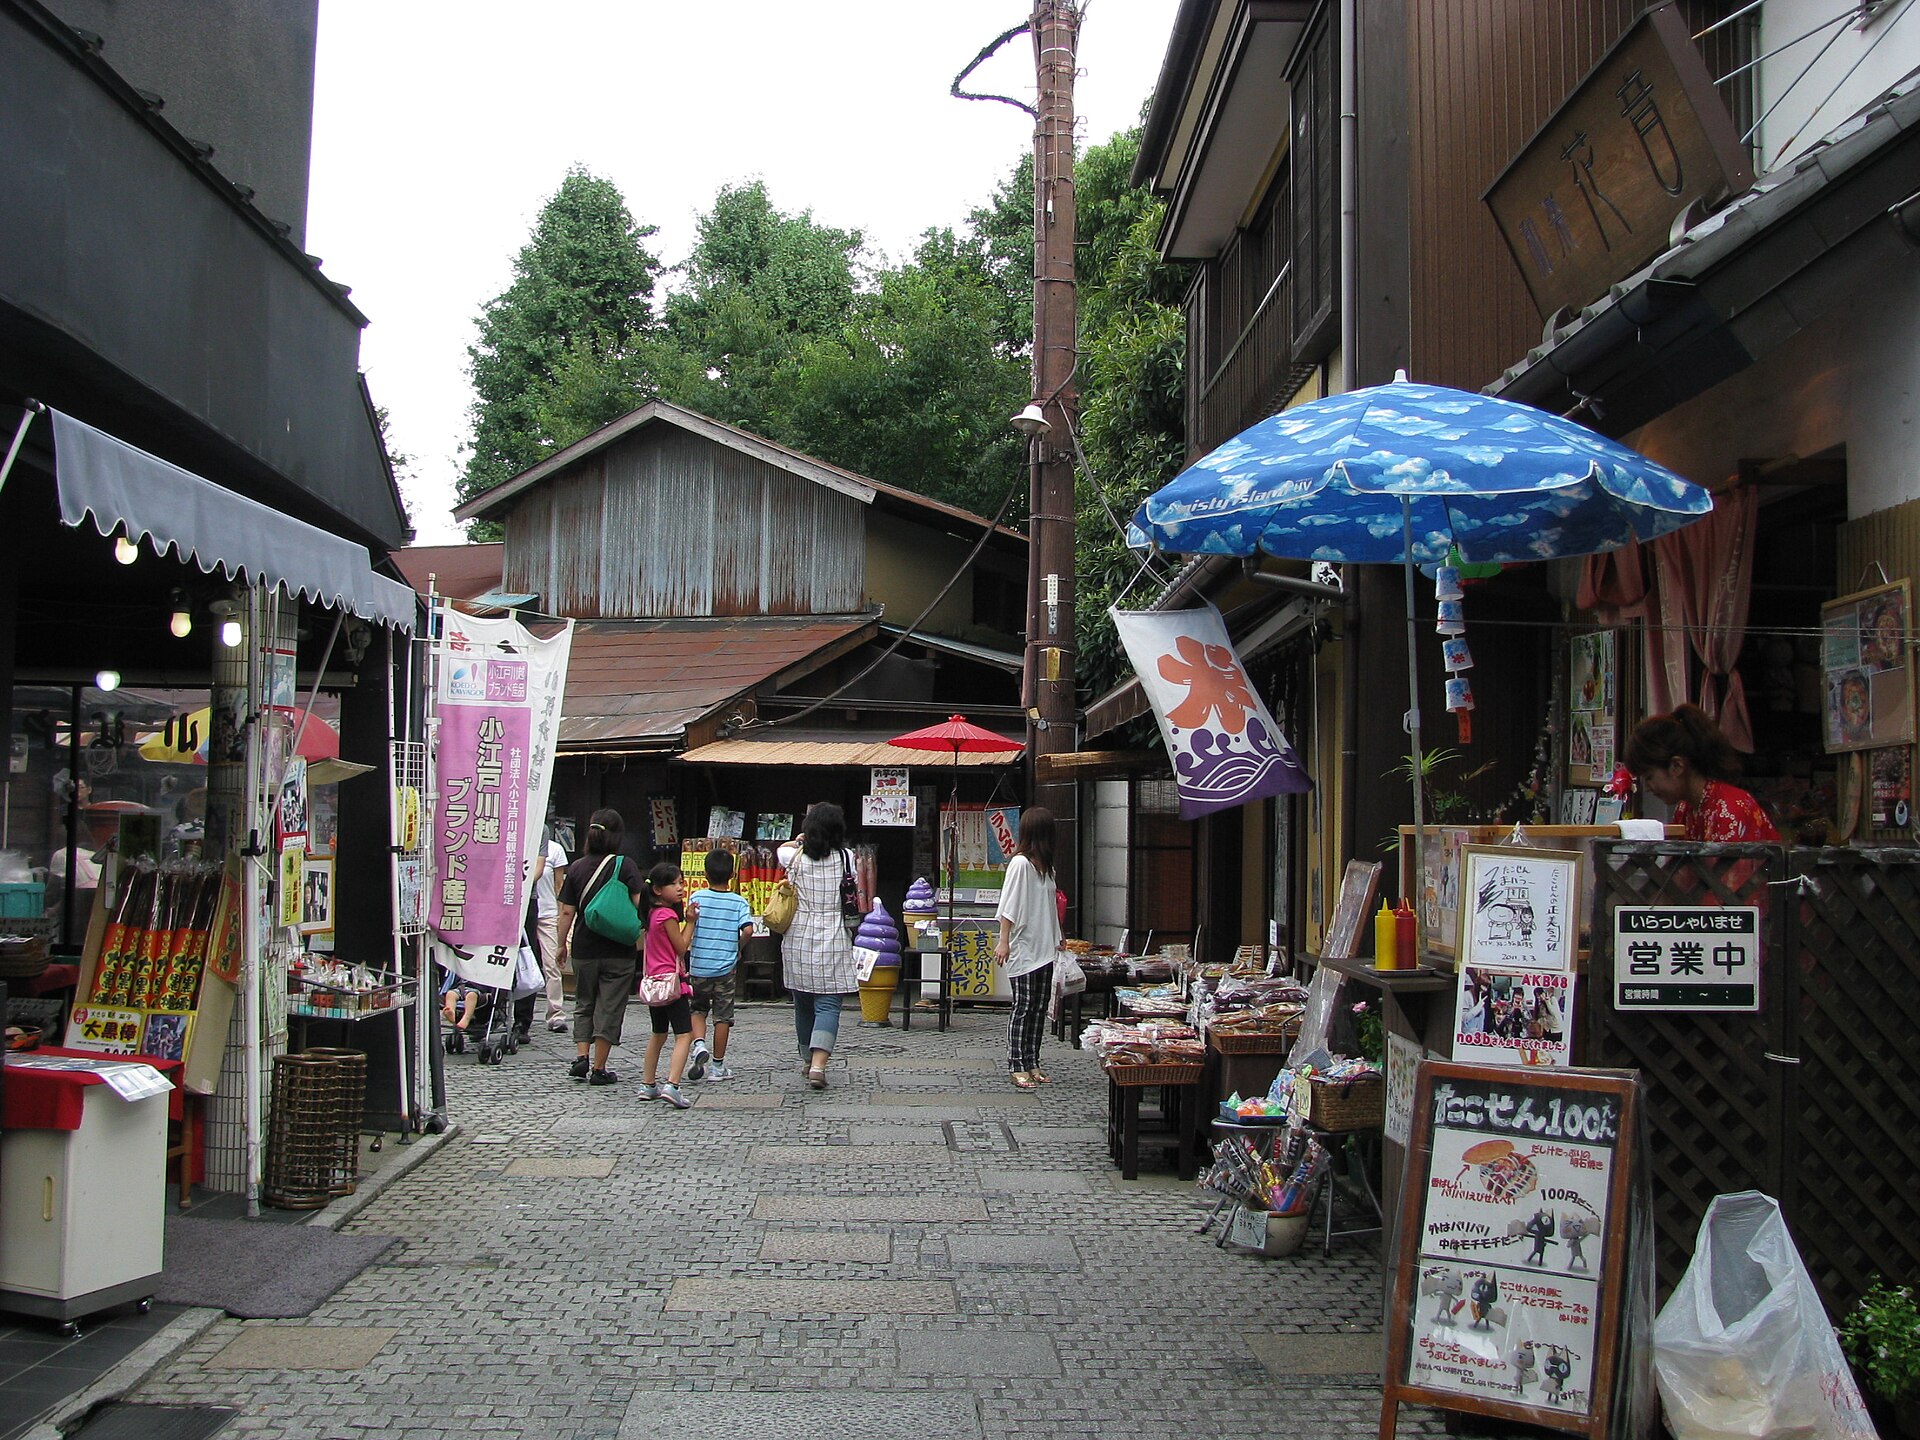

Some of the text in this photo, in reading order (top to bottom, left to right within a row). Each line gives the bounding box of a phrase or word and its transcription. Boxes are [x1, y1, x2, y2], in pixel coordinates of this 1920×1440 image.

[488, 665, 526, 680] 小江戸川越
[487, 682, 525, 698] ブランド産品
[473, 716, 505, 845] 小江戸川越
[503, 747, 522, 906] 社団法人小江戸川越観光協会認定
[990, 810, 1016, 856] ラムネ
[439, 777, 473, 932] ブランド産品
[1630, 915, 1743, 930] いらっしゃいませ
[973, 930, 993, 996] 昔ながらの
[1627, 940, 1746, 976] 営業中
[1521, 973, 1569, 989] AKB48
[1624, 989, 1660, 1000] 営業時間
[83, 1020, 138, 1041] 大黒棒
[1429, 1222, 1491, 1237] 外はパリパリ
[1503, 1294, 1590, 1315] ソースとマヨネーズを
